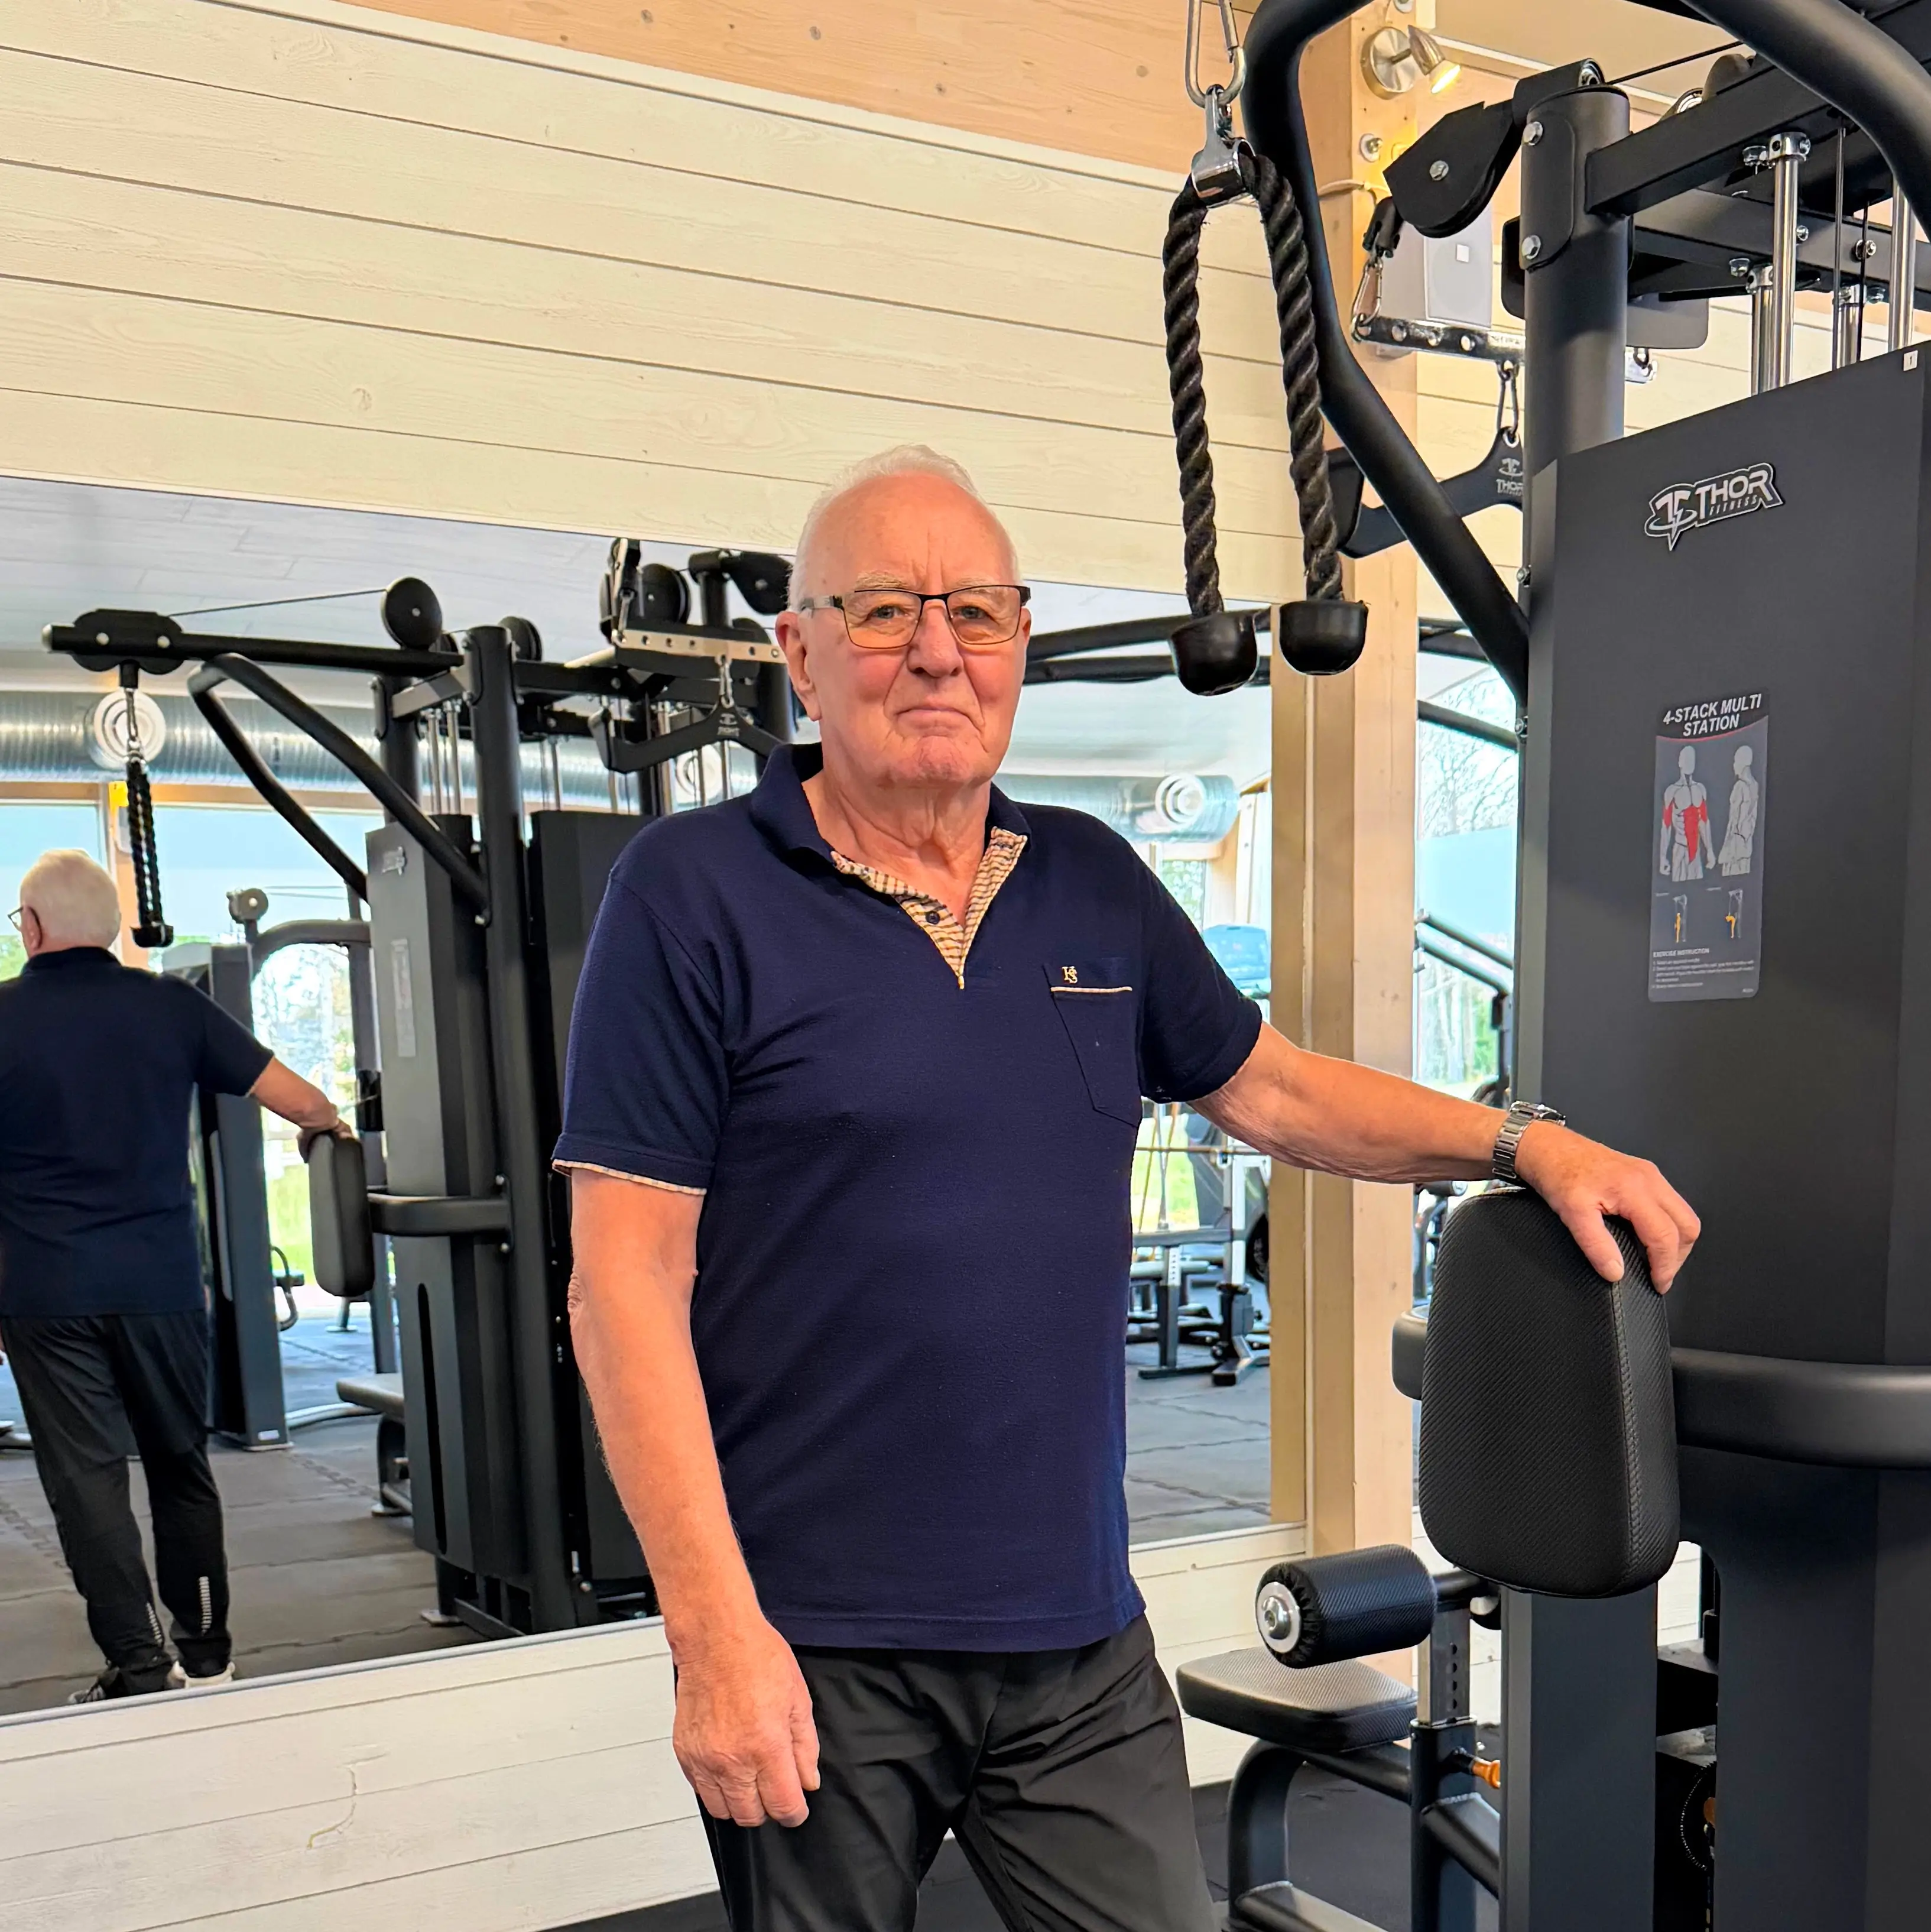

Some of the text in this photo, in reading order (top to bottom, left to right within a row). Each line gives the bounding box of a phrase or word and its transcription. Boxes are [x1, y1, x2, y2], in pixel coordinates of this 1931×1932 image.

[1695, 470, 1773, 520] THOR
[1663, 693, 1762, 725] 4-STACK MULTI
[1683, 714, 1740, 737] STATION
